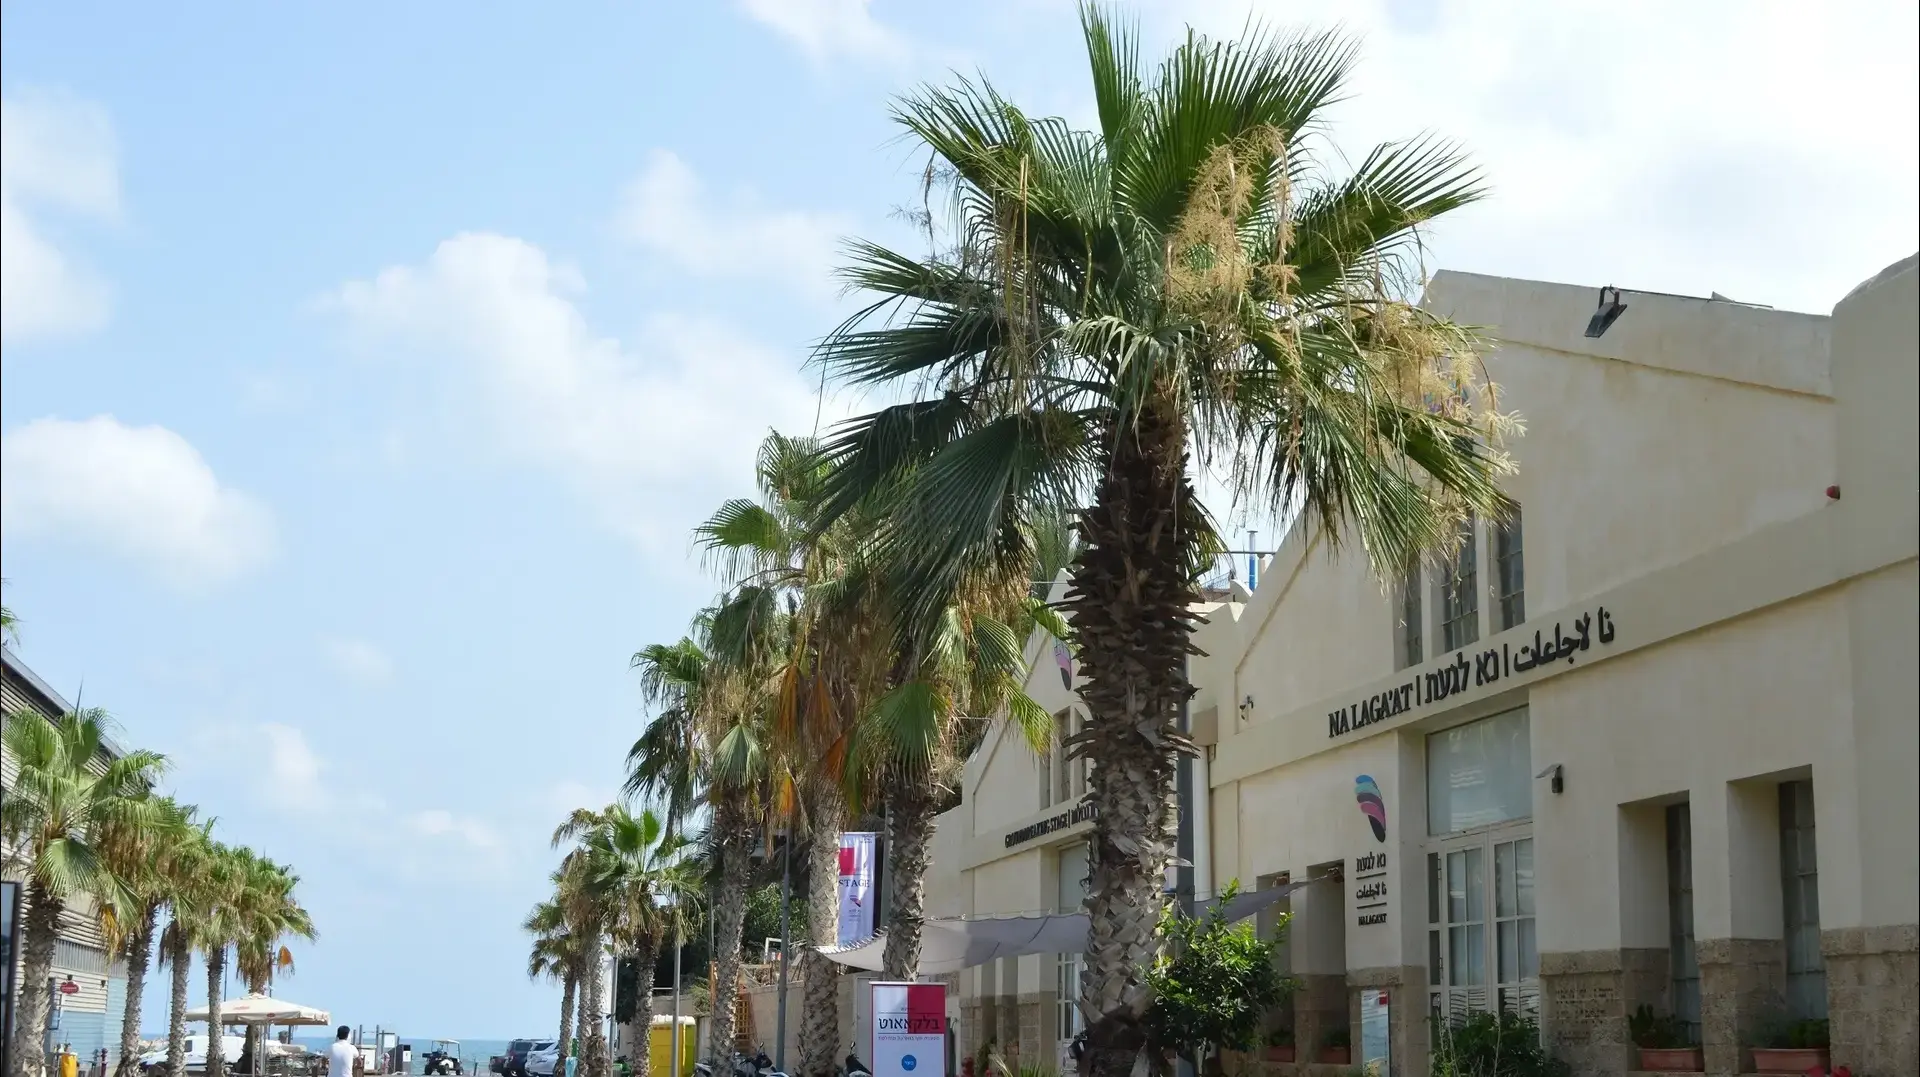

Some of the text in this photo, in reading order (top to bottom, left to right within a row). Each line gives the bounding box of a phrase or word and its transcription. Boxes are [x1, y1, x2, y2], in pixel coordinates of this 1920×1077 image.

[1598, 606, 1615, 643] نا
[1425, 648, 1499, 704] נא לגעת
[1328, 683, 1413, 738] NA LAGA'AT
[878, 1015, 940, 1033] בלקאאוט
